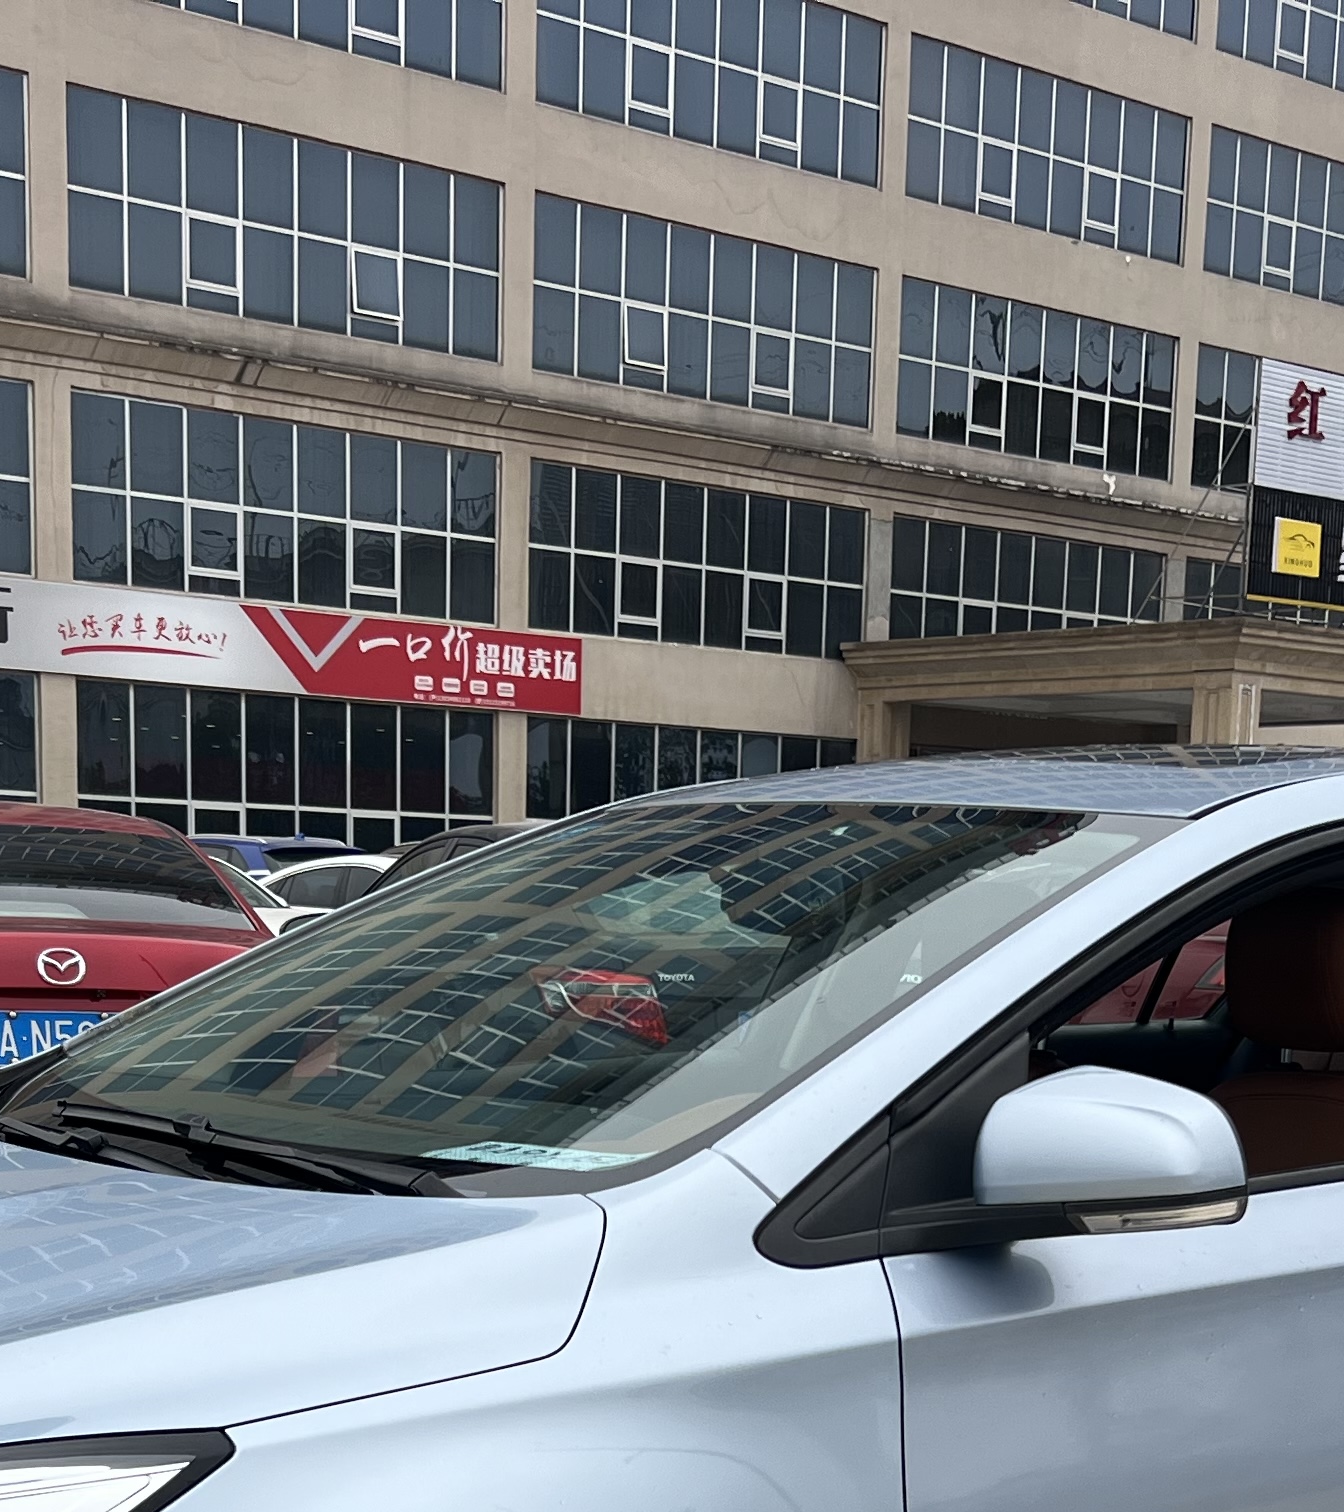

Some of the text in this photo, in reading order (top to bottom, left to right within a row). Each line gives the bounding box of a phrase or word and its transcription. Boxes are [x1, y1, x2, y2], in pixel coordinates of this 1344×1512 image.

[358, 625, 577, 682] 一口价 超级卖场
[657, 973, 695, 982] TOYOTA
